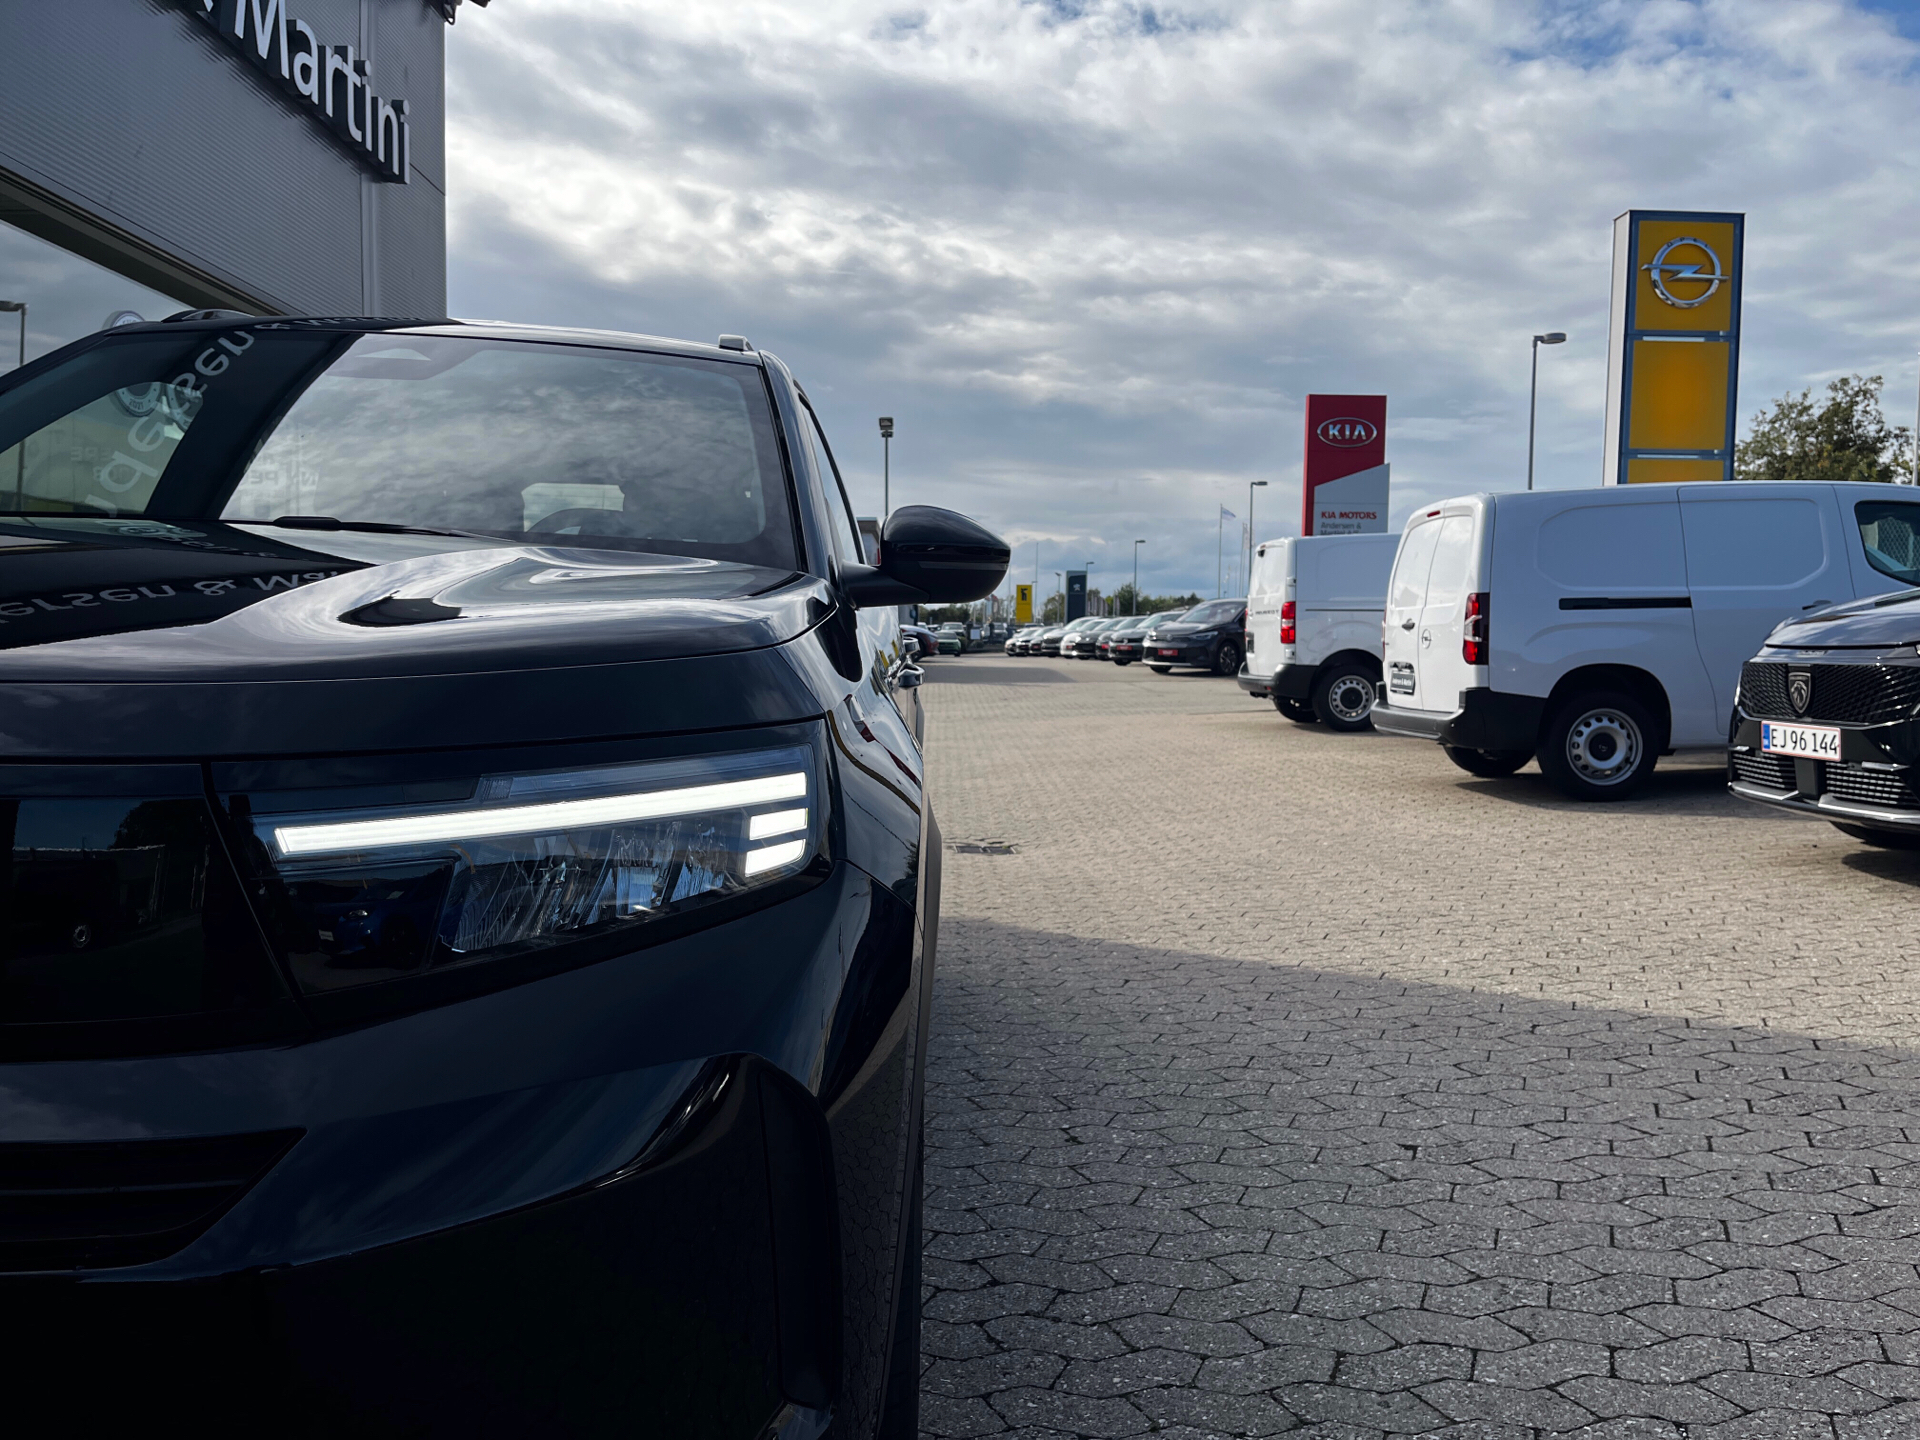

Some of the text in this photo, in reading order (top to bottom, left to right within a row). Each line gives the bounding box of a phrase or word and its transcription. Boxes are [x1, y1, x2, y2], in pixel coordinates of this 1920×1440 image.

[234, 0, 410, 184] Martini
[1328, 424, 1367, 440] KIA
[1321, 511, 1377, 520] KIA MOTORS
